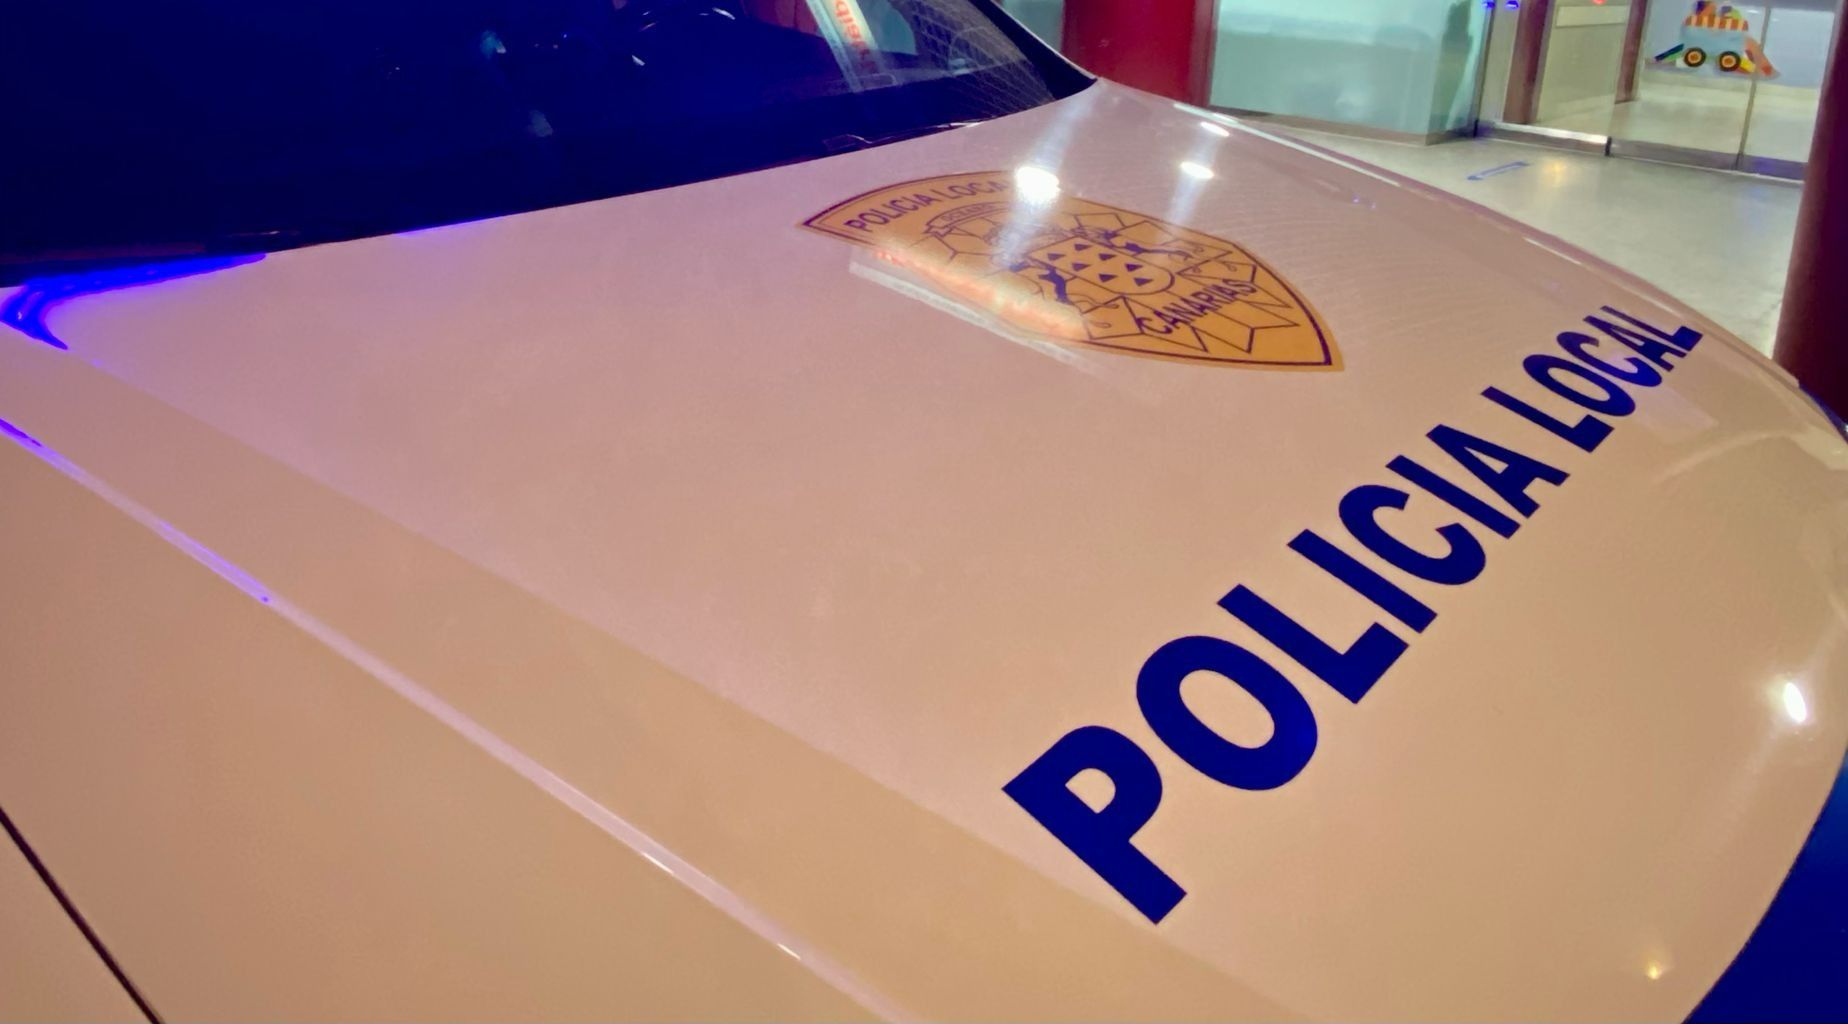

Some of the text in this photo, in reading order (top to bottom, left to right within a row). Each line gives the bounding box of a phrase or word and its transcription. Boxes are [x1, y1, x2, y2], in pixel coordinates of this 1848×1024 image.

[843, 180, 1012, 232] POLICIA LOCA
[1136, 279, 1257, 334] CANARIAS
[1002, 305, 1704, 926] POLICIA LOCAL
